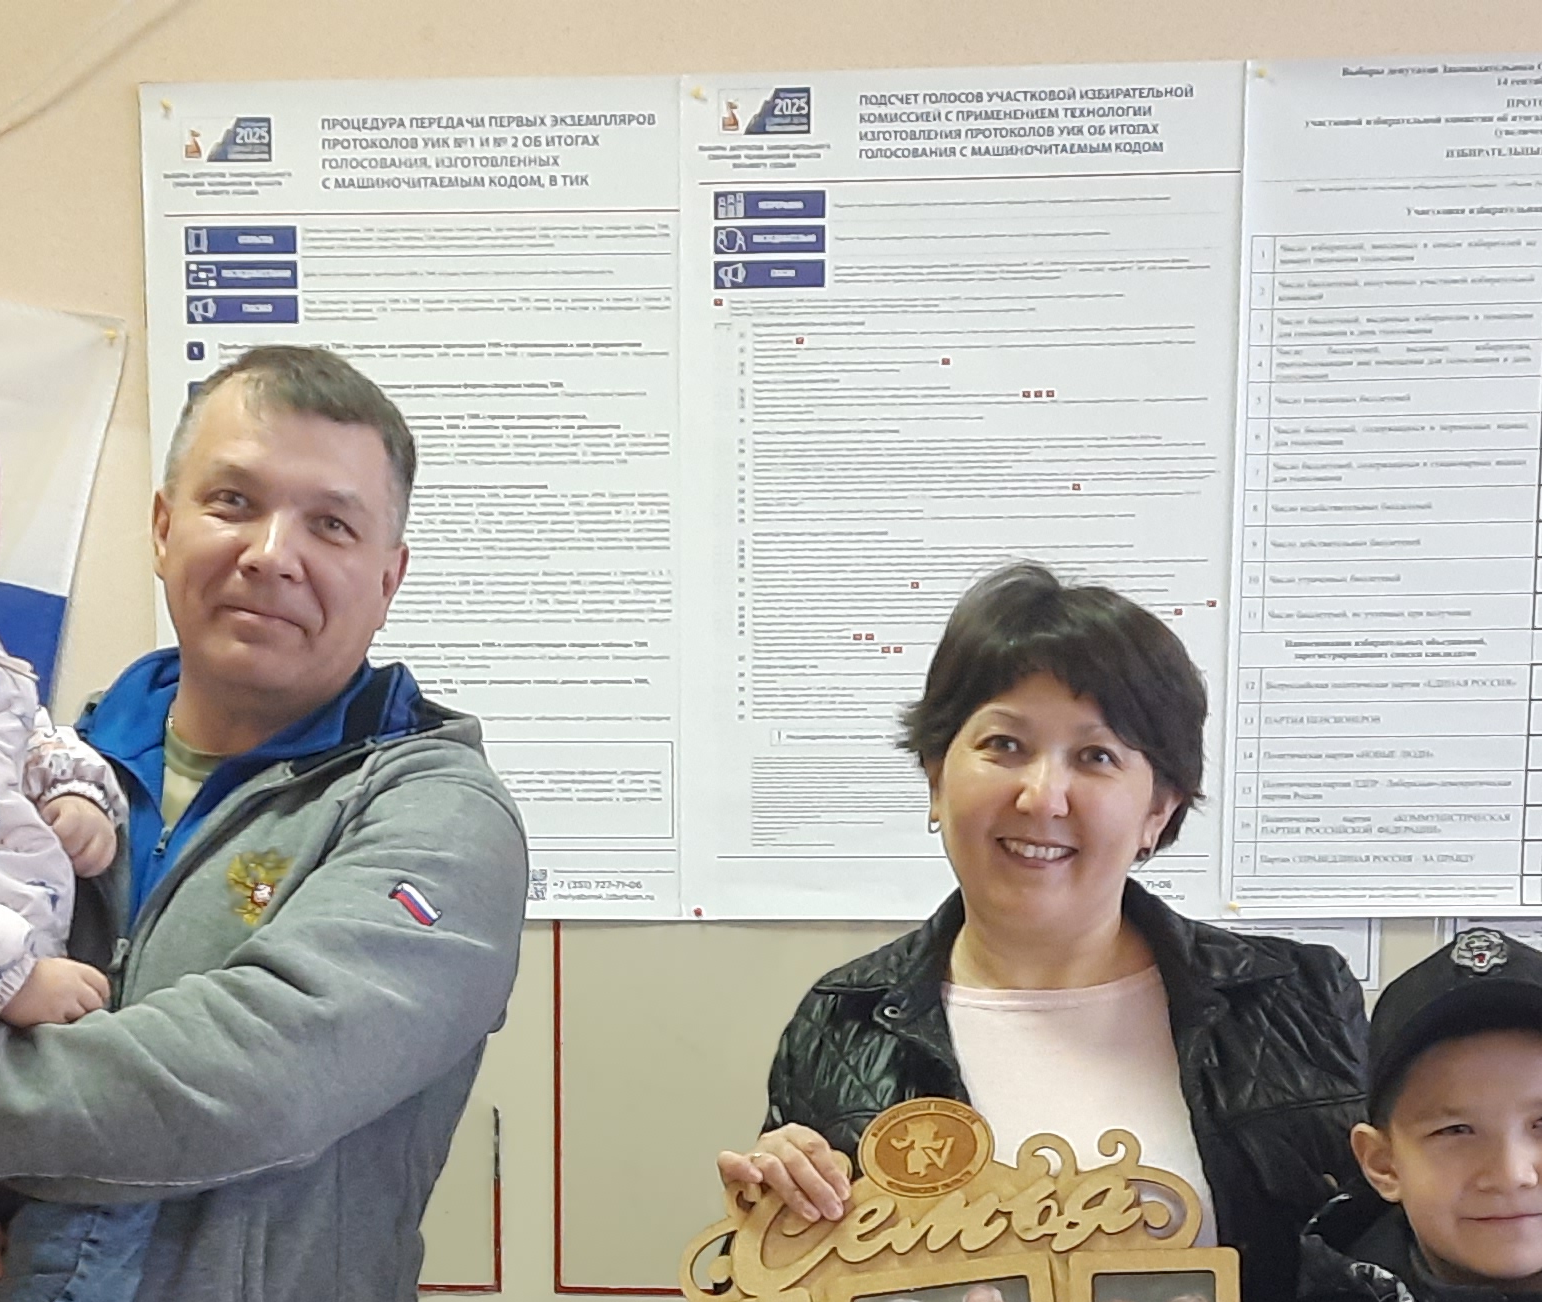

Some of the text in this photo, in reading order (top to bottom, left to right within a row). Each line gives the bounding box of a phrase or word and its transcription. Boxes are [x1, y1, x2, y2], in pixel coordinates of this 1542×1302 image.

[859, 84, 1194, 107] ПОДСЧЕТ ГОЛОСОВ УЧАСТКОВОЙ ИЗБИРАТЕЛЬНОЙ
[774, 99, 808, 115] 2025
[859, 105, 1152, 124] КОМИССИЕЙ С ПРИМЕНЕНИЕМ ТЕХНОЛОГИИ
[321, 114, 656, 132] ПРОЦЕДУРА ПЕРЕДАЧИ ПЕРВЫХ ЭКЗЕМПЛЯРОВ
[235, 127, 269, 144] 2025
[859, 123, 1159, 142] ИЗГОТОВЛЕНИЯ ПРОТОКОЛОВ УИК ОБ ИТОГАХ
[322, 138, 418, 150] ПРОТОКОЛОВ
[421, 137, 450, 149] УИК
[480, 136, 490, 148] И
[522, 135, 542, 147] ОБ
[545, 135, 600, 147] ИТОГАХ
[859, 141, 1164, 159] ГОЛОСОВАНИЯ С МАШИНОЧИТАЕМЫМ КОДОМ
[435, 155, 560, 169] ИЗГОТОВЛЕННЫХ
[322, 178, 331, 189] С
[334, 175, 486, 189] МАШИНОЧИТАЕМЫМ
[549, 175, 558, 187] В
[561, 174, 589, 187] ТИК
